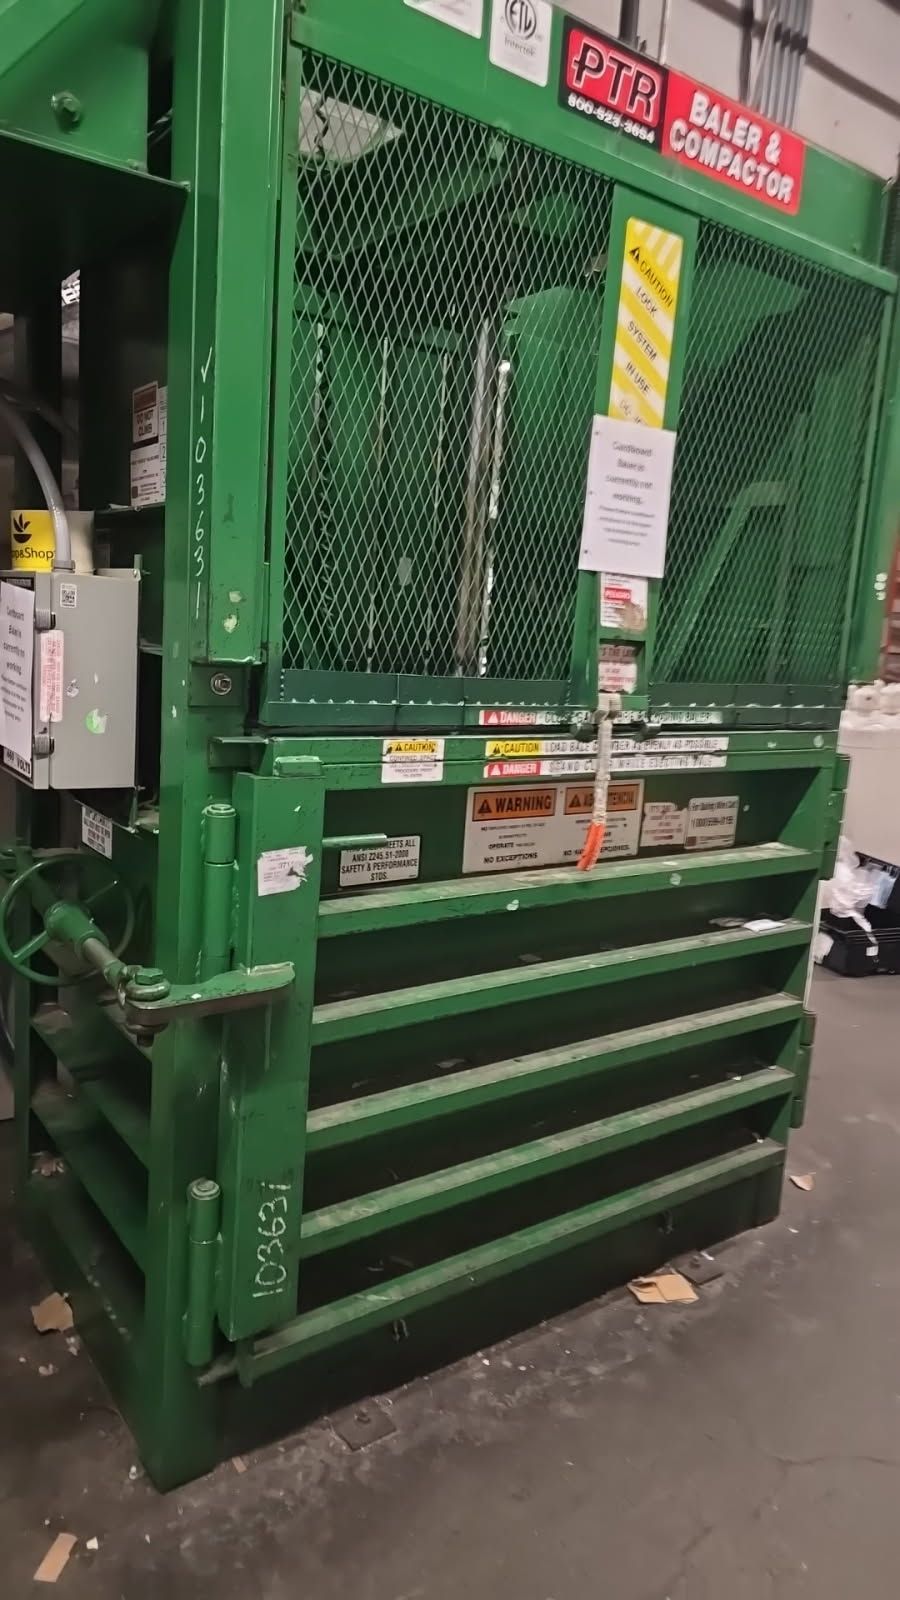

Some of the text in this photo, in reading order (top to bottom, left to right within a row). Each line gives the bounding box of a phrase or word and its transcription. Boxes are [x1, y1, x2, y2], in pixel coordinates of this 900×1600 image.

[572, 38, 659, 125] PTR
[689, 90, 781, 167] BALER &
[669, 118, 795, 204] COMPACTOR
[639, 260, 674, 308] CAUTION
[636, 286, 658, 319] LOCK
[627, 320, 658, 361] SYSTEM
[625, 361, 650, 395] IN USE
[500, 711, 537, 725] DANGER
[404, 743, 434, 753] CAUTION
[503, 743, 539, 754] CAUTION
[502, 763, 538, 775] DANGER
[495, 794, 552, 814] WARNING
[404, 839, 416, 847] ALL
[341, 859, 418, 875] SAFETY & PERFORMANCE
[351, 853, 368, 863] ANSI
[483, 852, 538, 864] NO EXCEPTIONS
[252, 1181, 291, 1298] 103631
